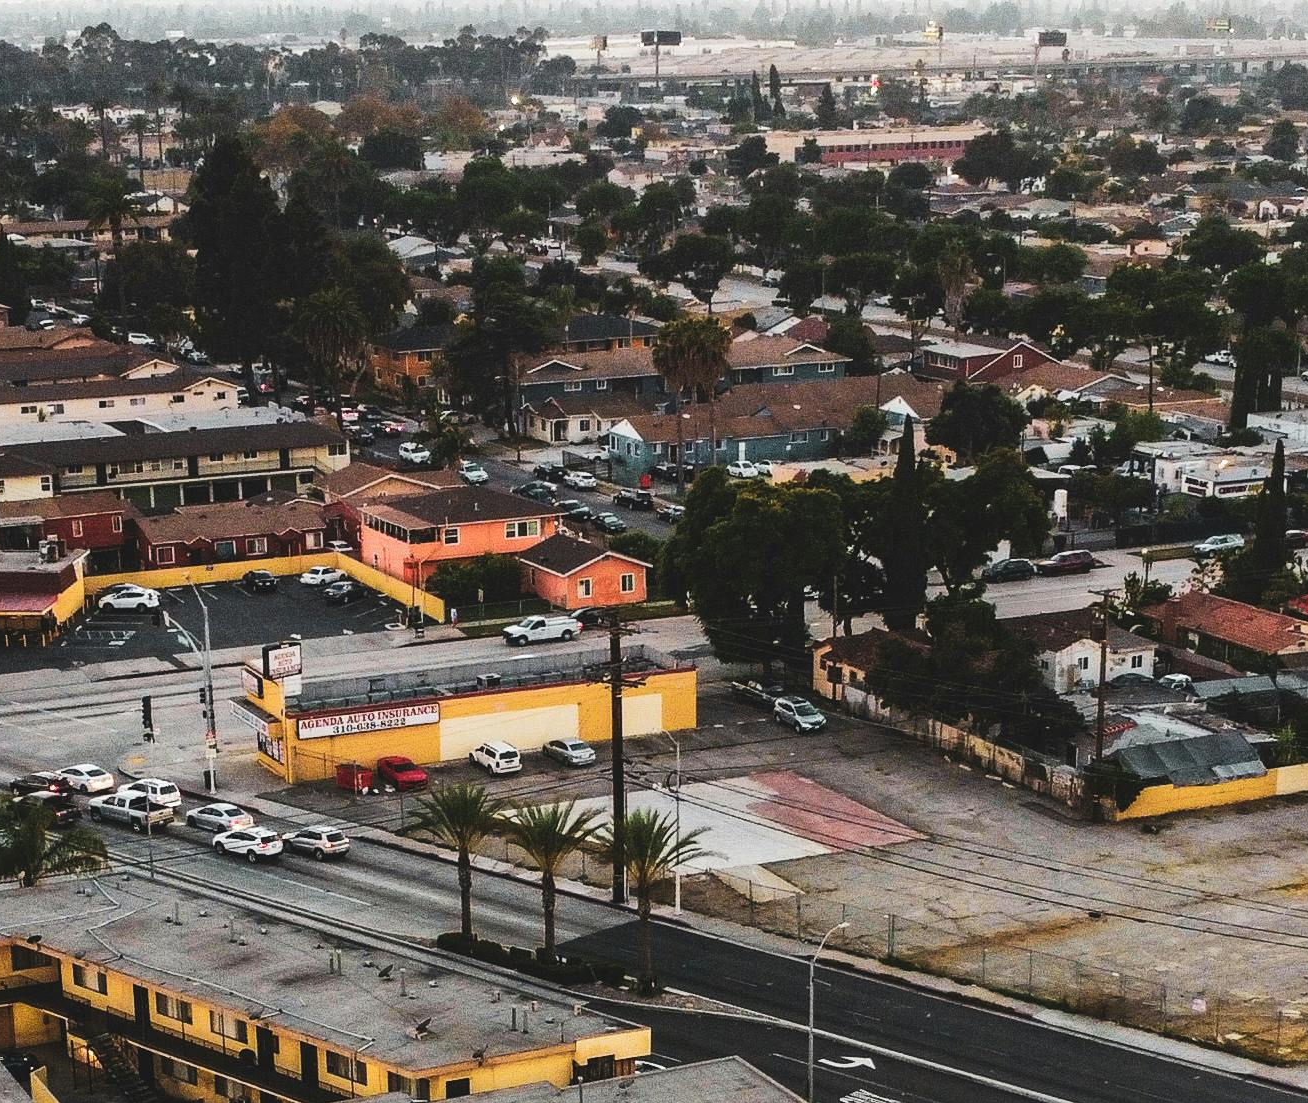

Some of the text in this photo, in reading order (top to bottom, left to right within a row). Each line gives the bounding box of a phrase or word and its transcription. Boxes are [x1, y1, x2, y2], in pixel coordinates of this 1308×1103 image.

[274, 651, 295, 661] AGENDA
[300, 705, 438, 730] AGENDA AUTO INSURANCE
[332, 718, 406, 734] 310-638-8222
